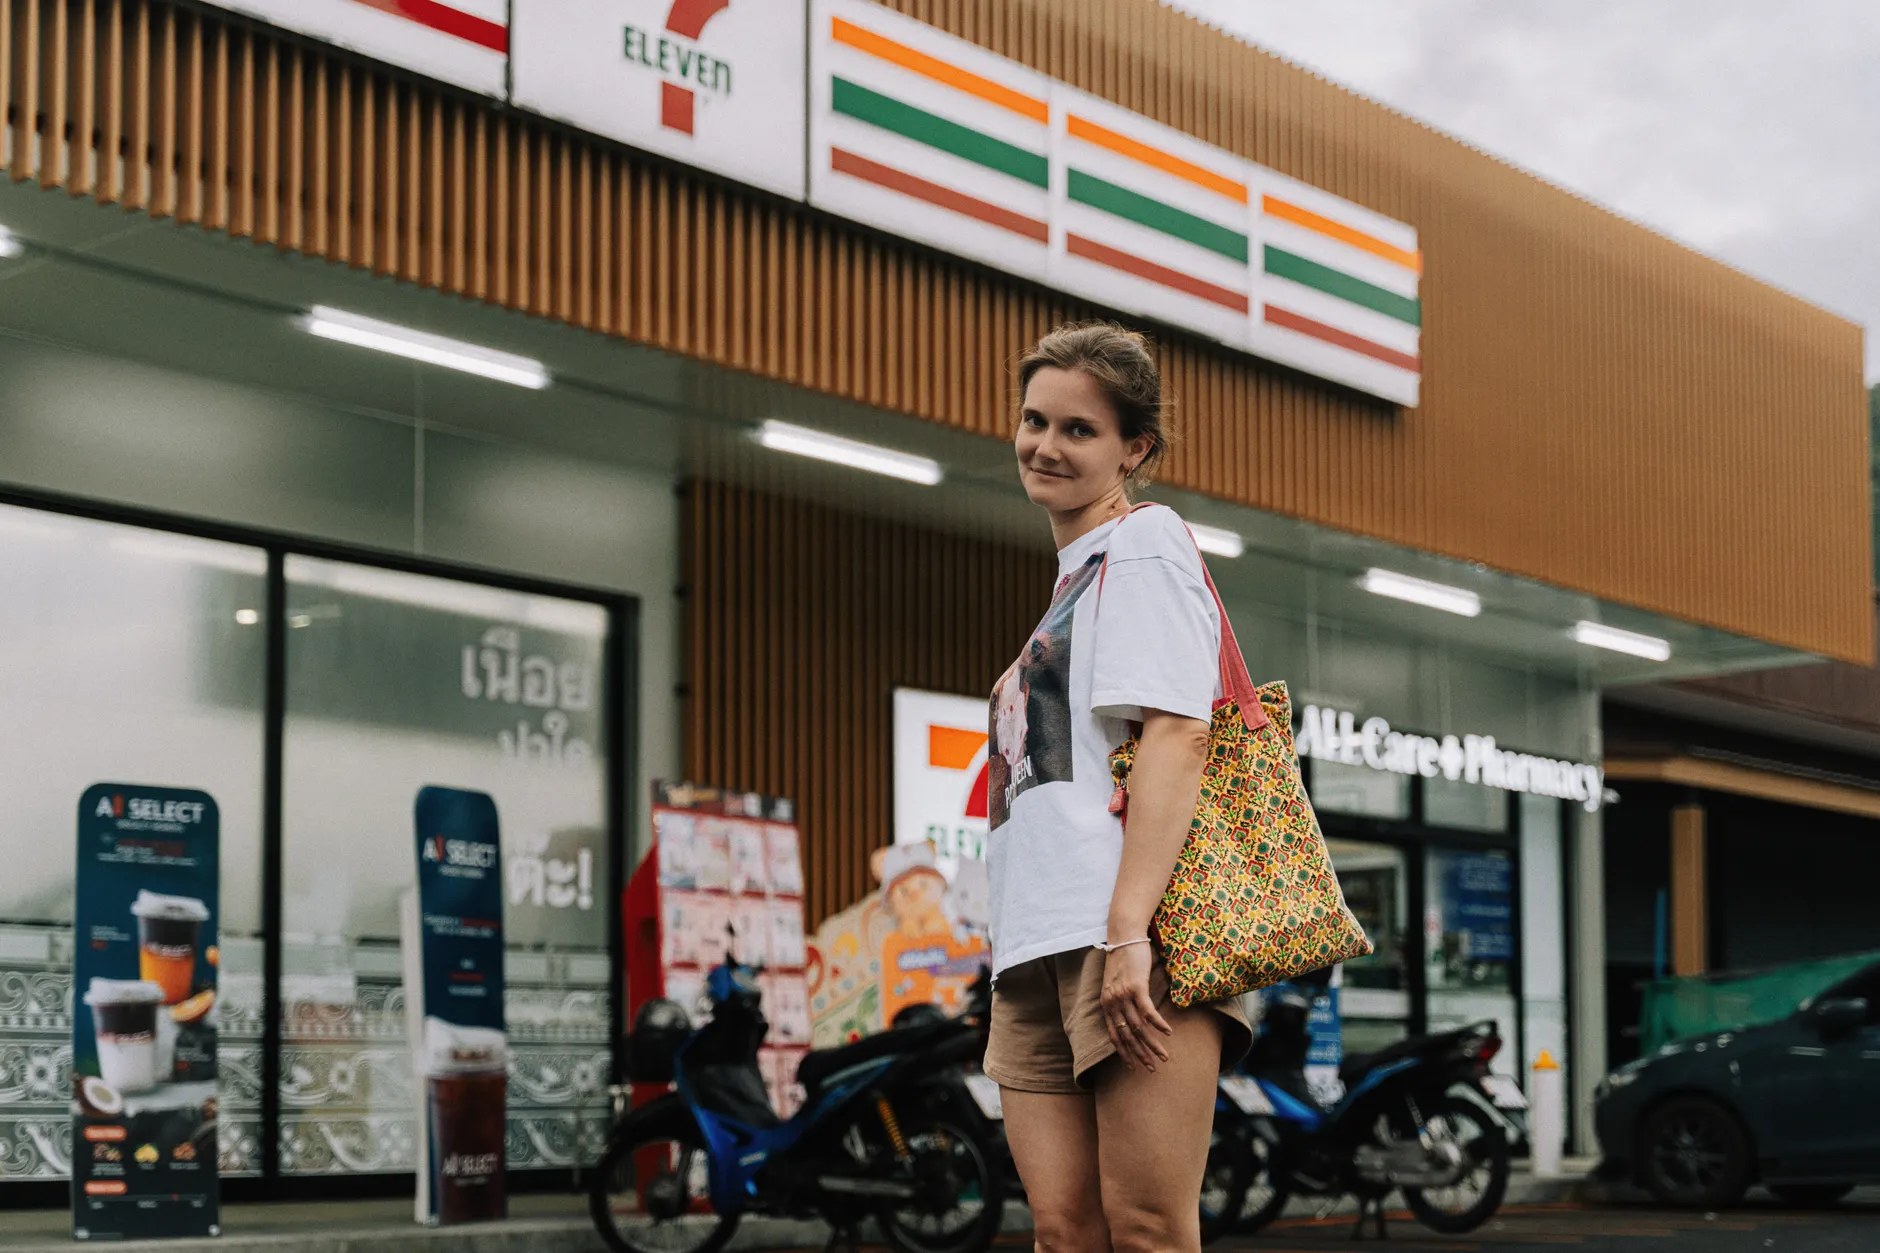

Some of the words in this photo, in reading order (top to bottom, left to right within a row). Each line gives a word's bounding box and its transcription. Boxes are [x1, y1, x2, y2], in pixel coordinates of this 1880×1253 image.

[1363, 717, 1440, 778] Care
[1464, 734, 1601, 812] Pharmacy
[128, 797, 205, 824] SELECT
[446, 838, 497, 868] SELECT
